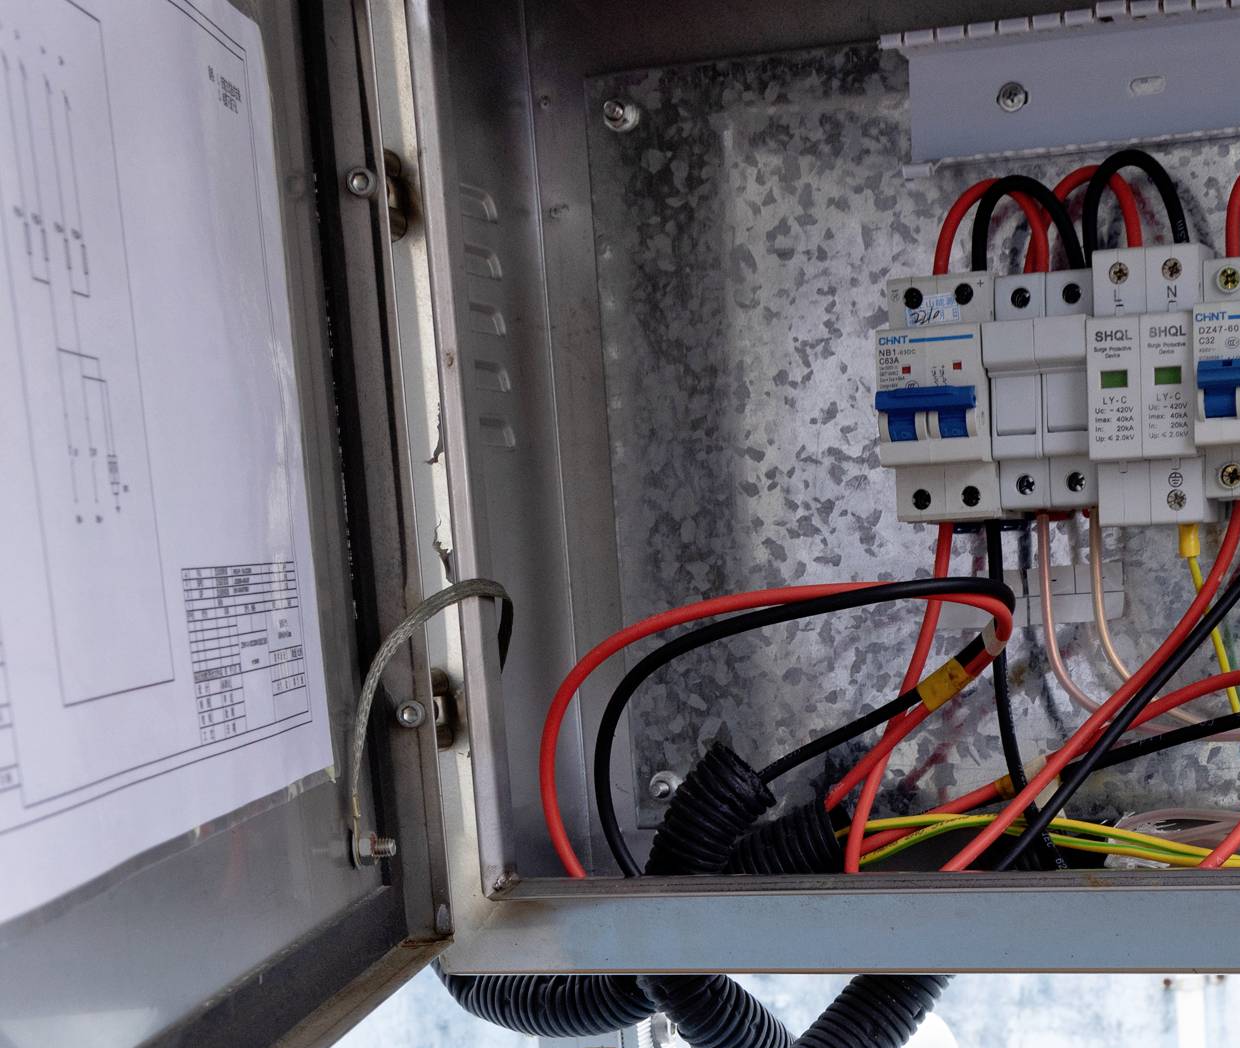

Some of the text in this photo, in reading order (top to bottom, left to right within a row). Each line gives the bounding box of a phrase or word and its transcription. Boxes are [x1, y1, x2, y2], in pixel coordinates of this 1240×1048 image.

[1166, 284, 1177, 298] N
[1195, 312, 1227, 322] CHNT
[1198, 324, 1239, 335] DZ47-60
[878, 335, 908, 346] CHNT
[1095, 329, 1132, 343] SHQL
[1198, 336, 1215, 345] C32
[1102, 395, 1127, 405] LY-C
[1169, 402, 1187, 410] 420V
